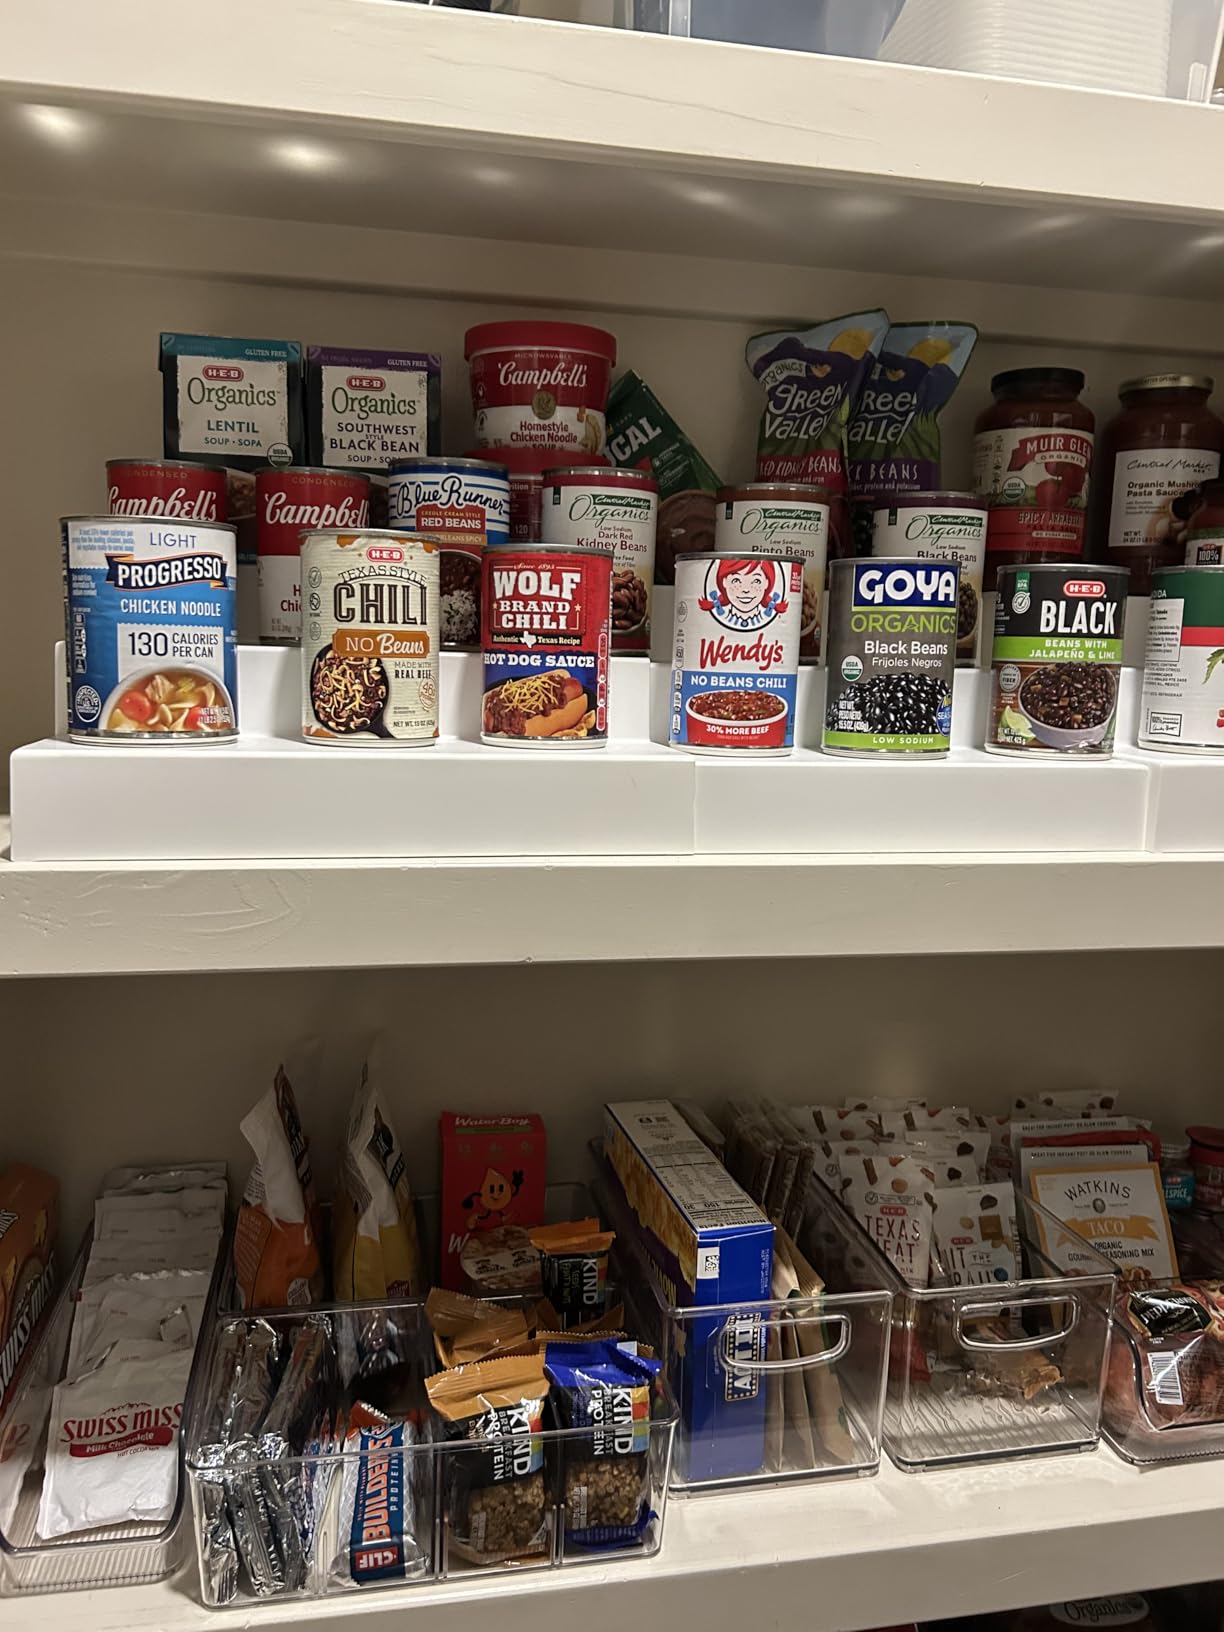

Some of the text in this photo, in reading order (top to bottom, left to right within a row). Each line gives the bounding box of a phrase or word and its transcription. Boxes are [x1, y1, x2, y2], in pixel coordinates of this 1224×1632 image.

[271, 350, 287, 358] FREE
[388, 358, 428, 368] GLUTEN FREE
[498, 361, 588, 390] Campbell's
[187, 377, 277, 411] Organics
[331, 386, 417, 420] Organics
[207, 420, 259, 434] LENTIL
[337, 422, 416, 436] SOUTHWEST
[520, 421, 568, 433] Homestyle
[204, 436, 262, 448] SOUP SOPA
[330, 438, 419, 453] BLACK BEAN
[510, 432, 578, 444] Chicken Noodle
[1026, 436, 1064, 455] MUIR
[348, 455, 372, 463] SOUP
[807, 456, 842, 474] BEANS
[870, 464, 918, 481] BEANS
[1127, 480, 1165, 490] Organic
[1127, 488, 1184, 498] Pasta Sauce
[396, 476, 504, 516] Blue Runner
[568, 494, 650, 528] Organics
[421, 518, 482, 528] RED BEANS
[515, 525, 528, 534] 120
[740, 508, 820, 541] Organics
[905, 514, 982, 546] Organics
[150, 532, 197, 549] LIGHT
[466, 534, 482, 543] SPICY
[598, 532, 634, 540] Dark Red
[576, 538, 648, 553] Kidney Beans
[752, 545, 815, 558] Pinto Beans
[917, 550, 977, 562] Black Beans
[118, 557, 222, 588] PROGRESSO
[338, 565, 428, 586] TEXAS STYLE
[493, 570, 581, 600] WOLF
[858, 569, 956, 604] GOYA
[120, 599, 222, 617] CHICKEN NOODLE
[333, 582, 428, 626] CHILI
[499, 600, 571, 613] BRAND
[502, 613, 568, 630] CHILI
[851, 614, 956, 634] ORGANICS
[1040, 600, 1118, 635] BLACK
[128, 632, 219, 657] 130 CALORIES
[346, 633, 424, 655] NO Beans
[493, 634, 580, 646] Authentic Texas Recipe
[864, 640, 948, 656] Black Beans
[1045, 640, 1108, 649] BEANS WITH
[172, 646, 214, 658] PER CAN
[700, 632, 784, 670] Wendy's
[1029, 648, 1116, 660] JALAPEÑO & LIME
[484, 653, 595, 668] HOT DOG SAUCE
[872, 656, 942, 669] Frijoles Negros
[394, 669, 432, 679] REAL BEEF
[690, 675, 787, 688] NO BEANS CHILI
[706, 724, 770, 735] 30% MORE BEEF
[872, 736, 895, 744] LOW
[1064, 1179, 1131, 1202] WATKINS
[864, 1215, 920, 1241] TEXAS
[1086, 1220, 1125, 1236] TACO
[1094, 1240, 1122, 1250] ORGANIC
[1142, 1248, 1155, 1257] MIX
[972, 1254, 992, 1263] THE
[583, 1258, 598, 1305] KIND
[60, 1403, 184, 1442] SWISS MISS
[591, 1388, 604, 1456] PROTEIN
[612, 1388, 633, 1454] KIND
[86, 1431, 154, 1454] Milk Chocolate
[488, 1412, 504, 1481] PROTEIN
[506, 1407, 532, 1476] KIND
[117, 1446, 148, 1458] HOT COCOA
[390, 1449, 400, 1512] PROTEIN
[362, 1434, 393, 1546] BUILDERS
[359, 1550, 397, 1568] CLIF
[1064, 1600, 1132, 1623] Organics
